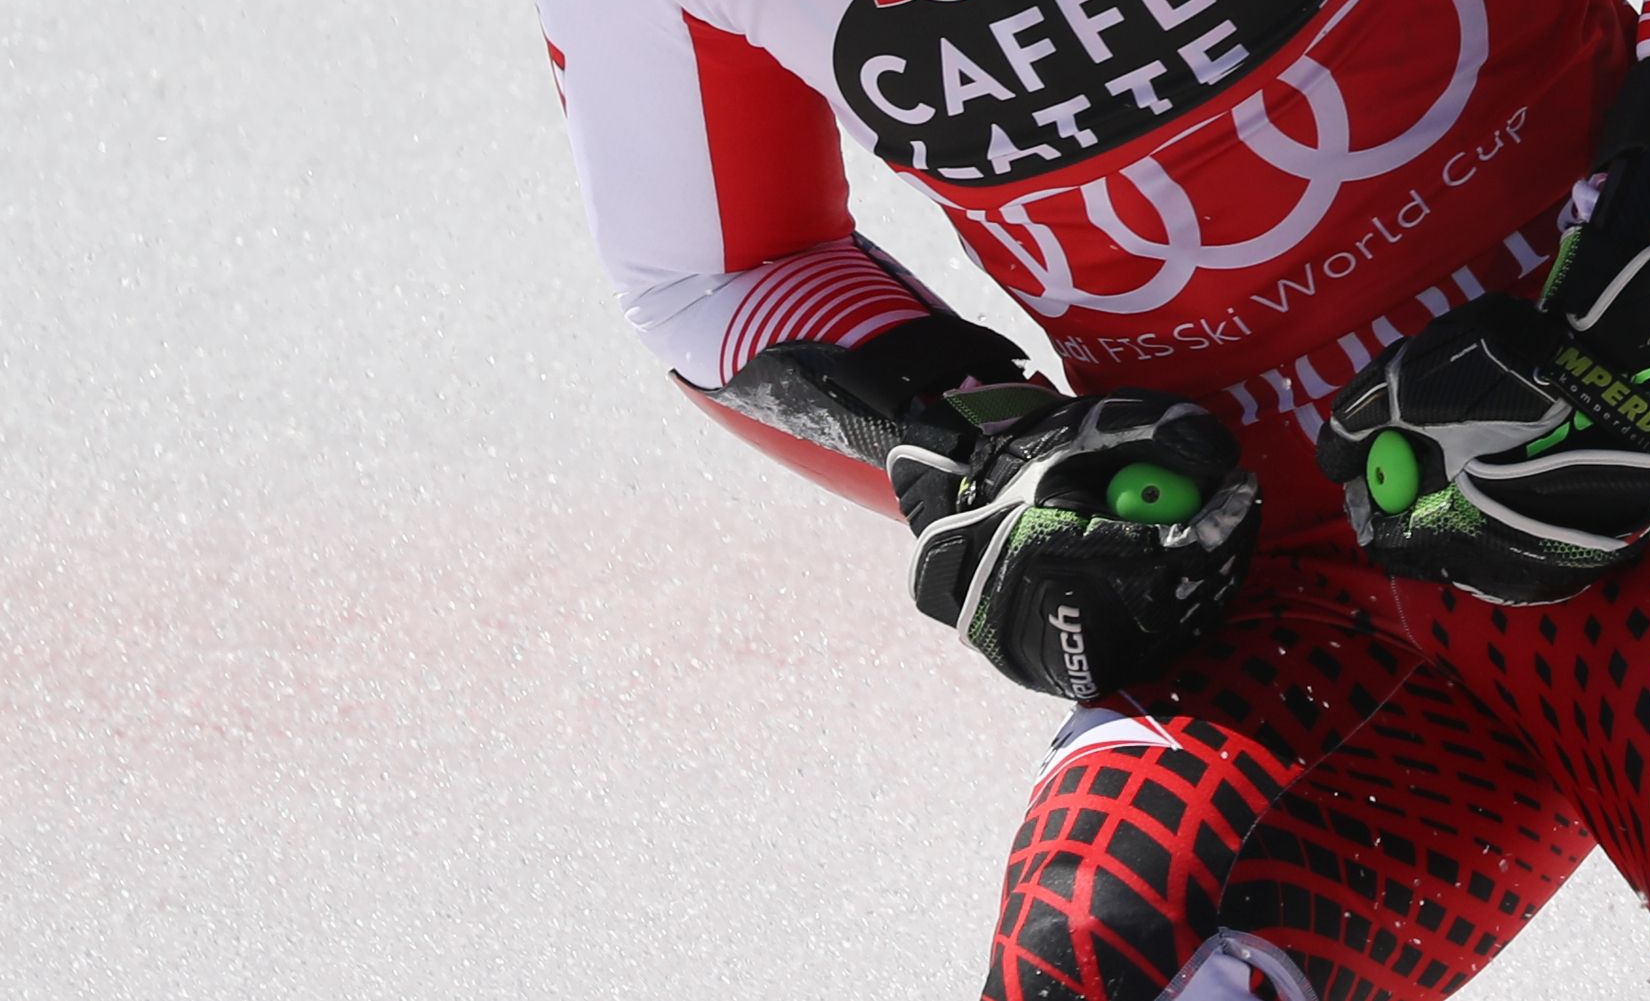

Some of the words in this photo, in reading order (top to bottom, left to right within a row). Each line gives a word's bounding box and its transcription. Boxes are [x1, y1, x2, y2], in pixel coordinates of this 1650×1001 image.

[1054, 335, 1099, 364] udi
[1098, 332, 1175, 363] FIS
[1173, 307, 1251, 349] Ski
[1250, 189, 1431, 313] World
[1442, 106, 1529, 188] Cup
